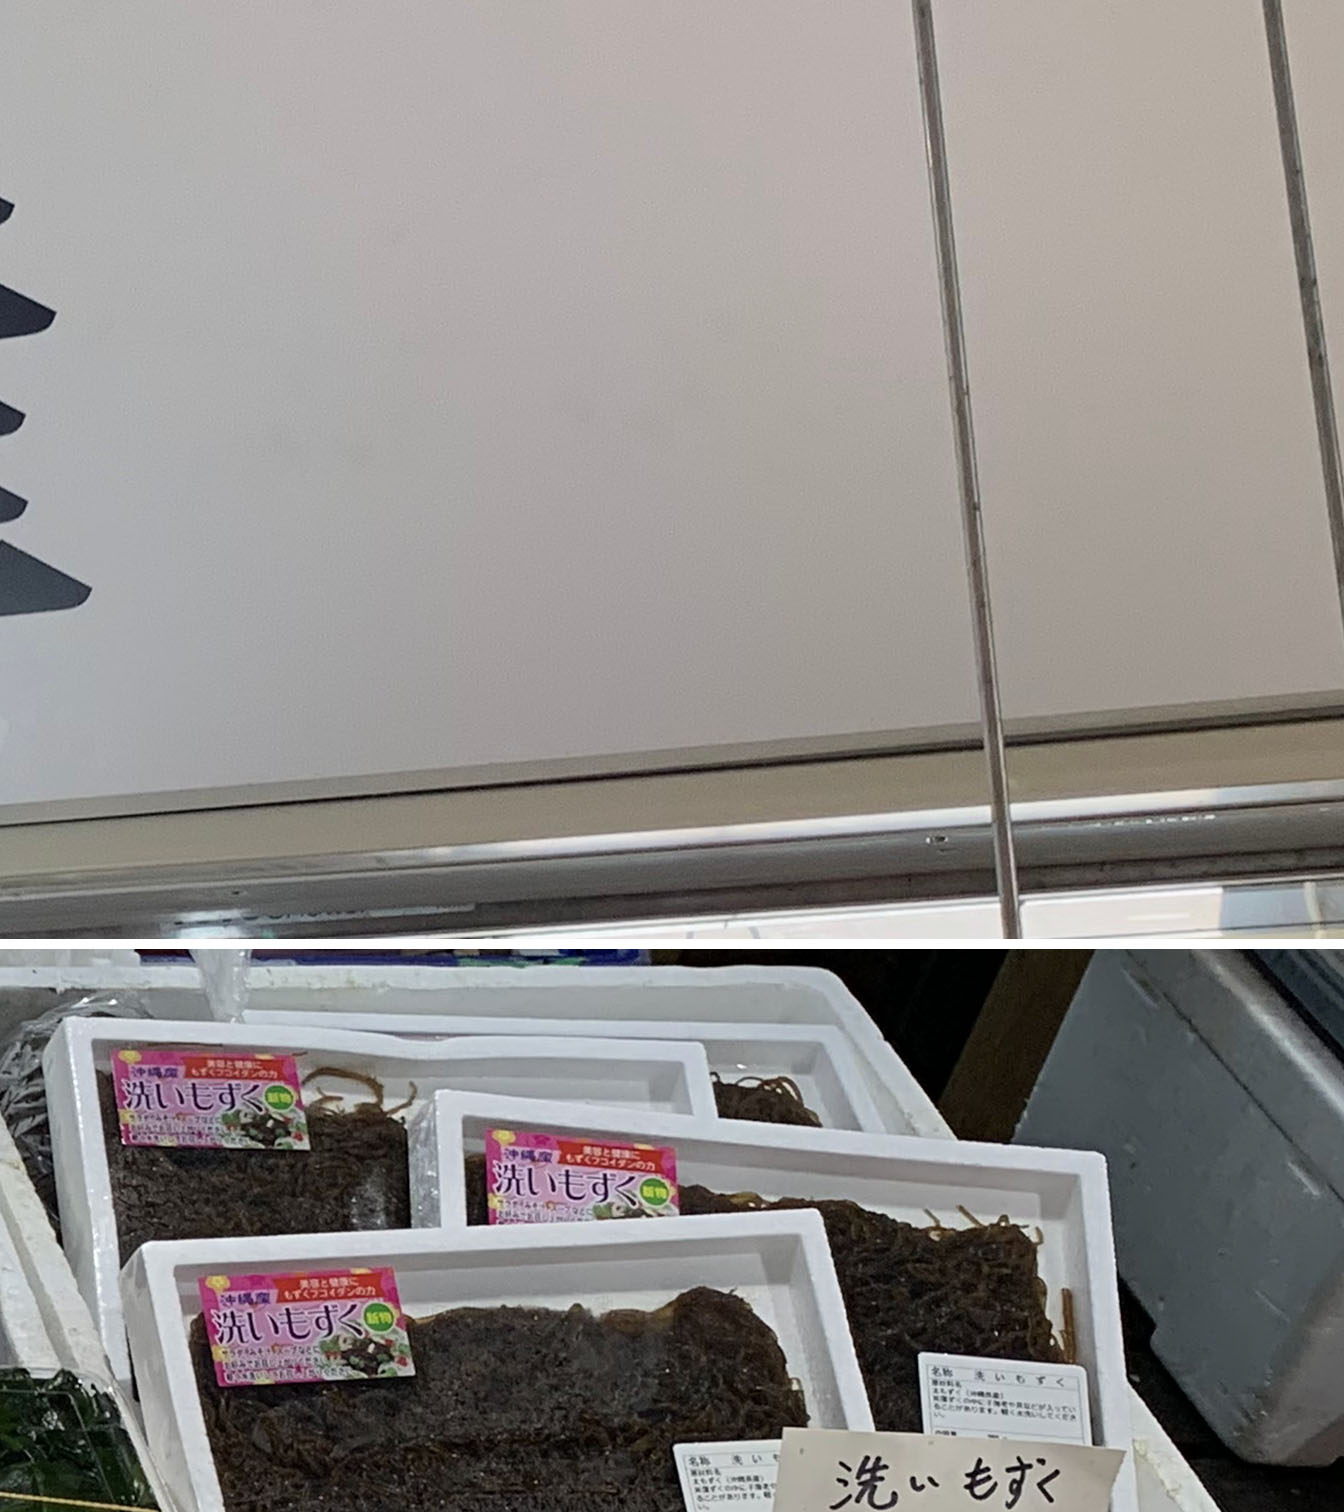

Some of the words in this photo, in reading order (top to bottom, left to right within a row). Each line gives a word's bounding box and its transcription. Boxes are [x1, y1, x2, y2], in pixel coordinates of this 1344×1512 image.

[124, 1081, 264, 1112] 洗いもずく
[493, 1161, 638, 1208] 洗いもずく
[212, 1303, 365, 1345] 洗いもずく
[830, 1455, 1061, 1511] 洗いもずく
